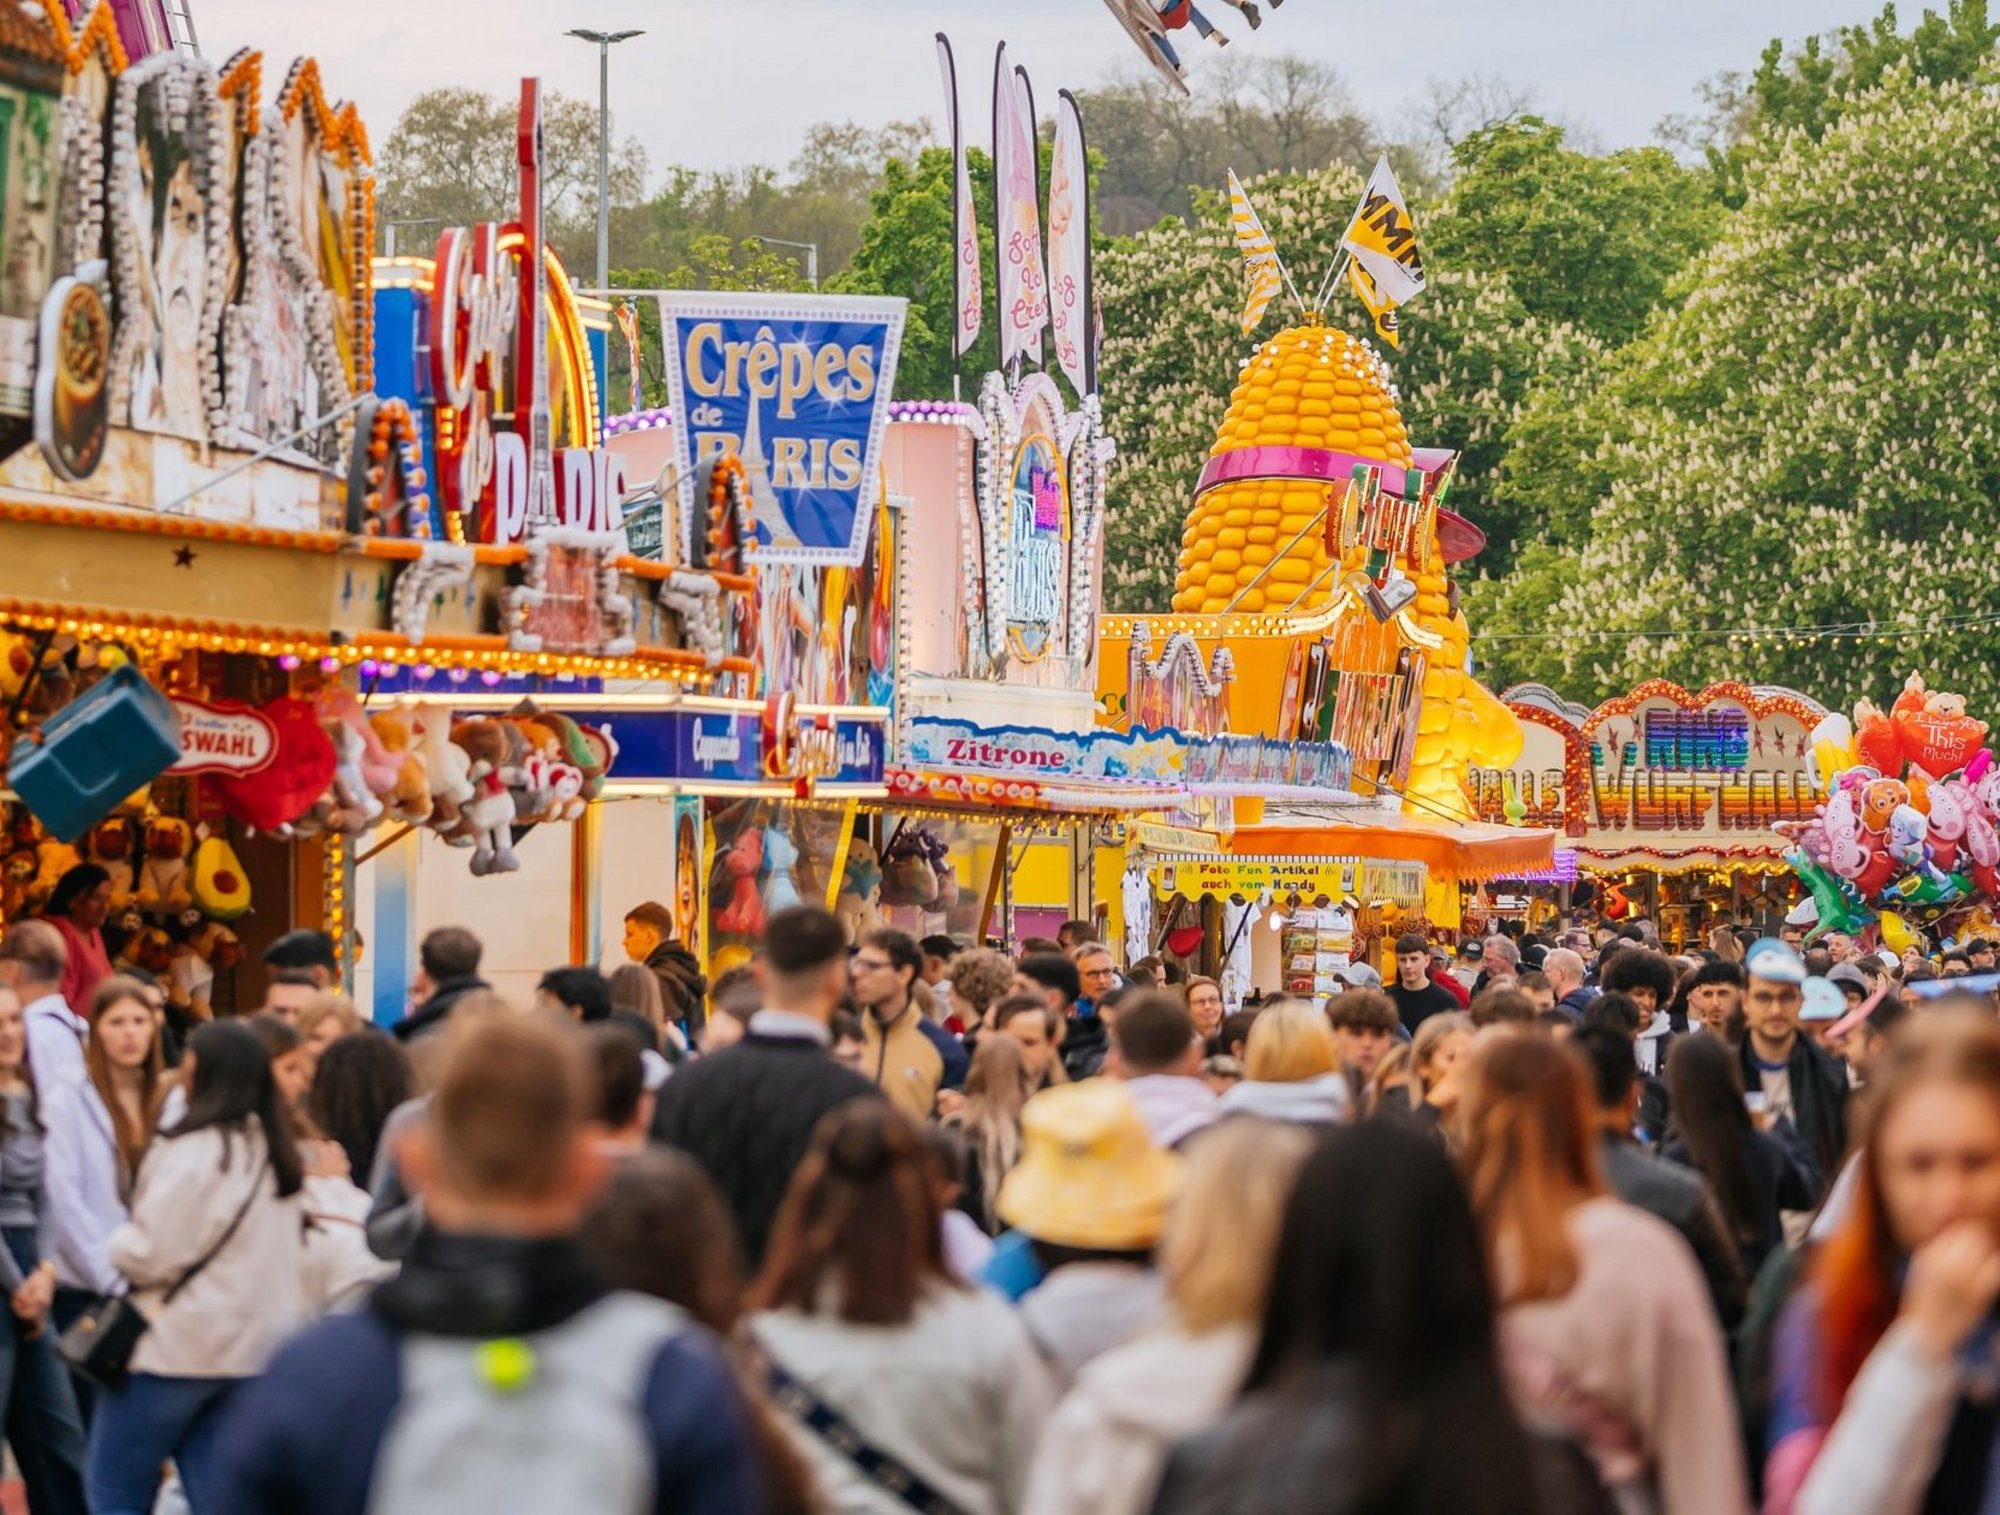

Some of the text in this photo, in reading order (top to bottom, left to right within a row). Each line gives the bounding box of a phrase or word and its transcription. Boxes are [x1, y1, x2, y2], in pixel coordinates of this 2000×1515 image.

[685, 322, 875, 419] Crêpes
[691, 402, 724, 427] de
[181, 730, 256, 758] SWAHL
[1921, 724, 1966, 750] This
[947, 738, 1065, 768] Zitrone
[1200, 864, 1319, 876] Foto Fun Artikel
[1201, 879, 1232, 890] auch
[1239, 881, 1265, 891] vom
